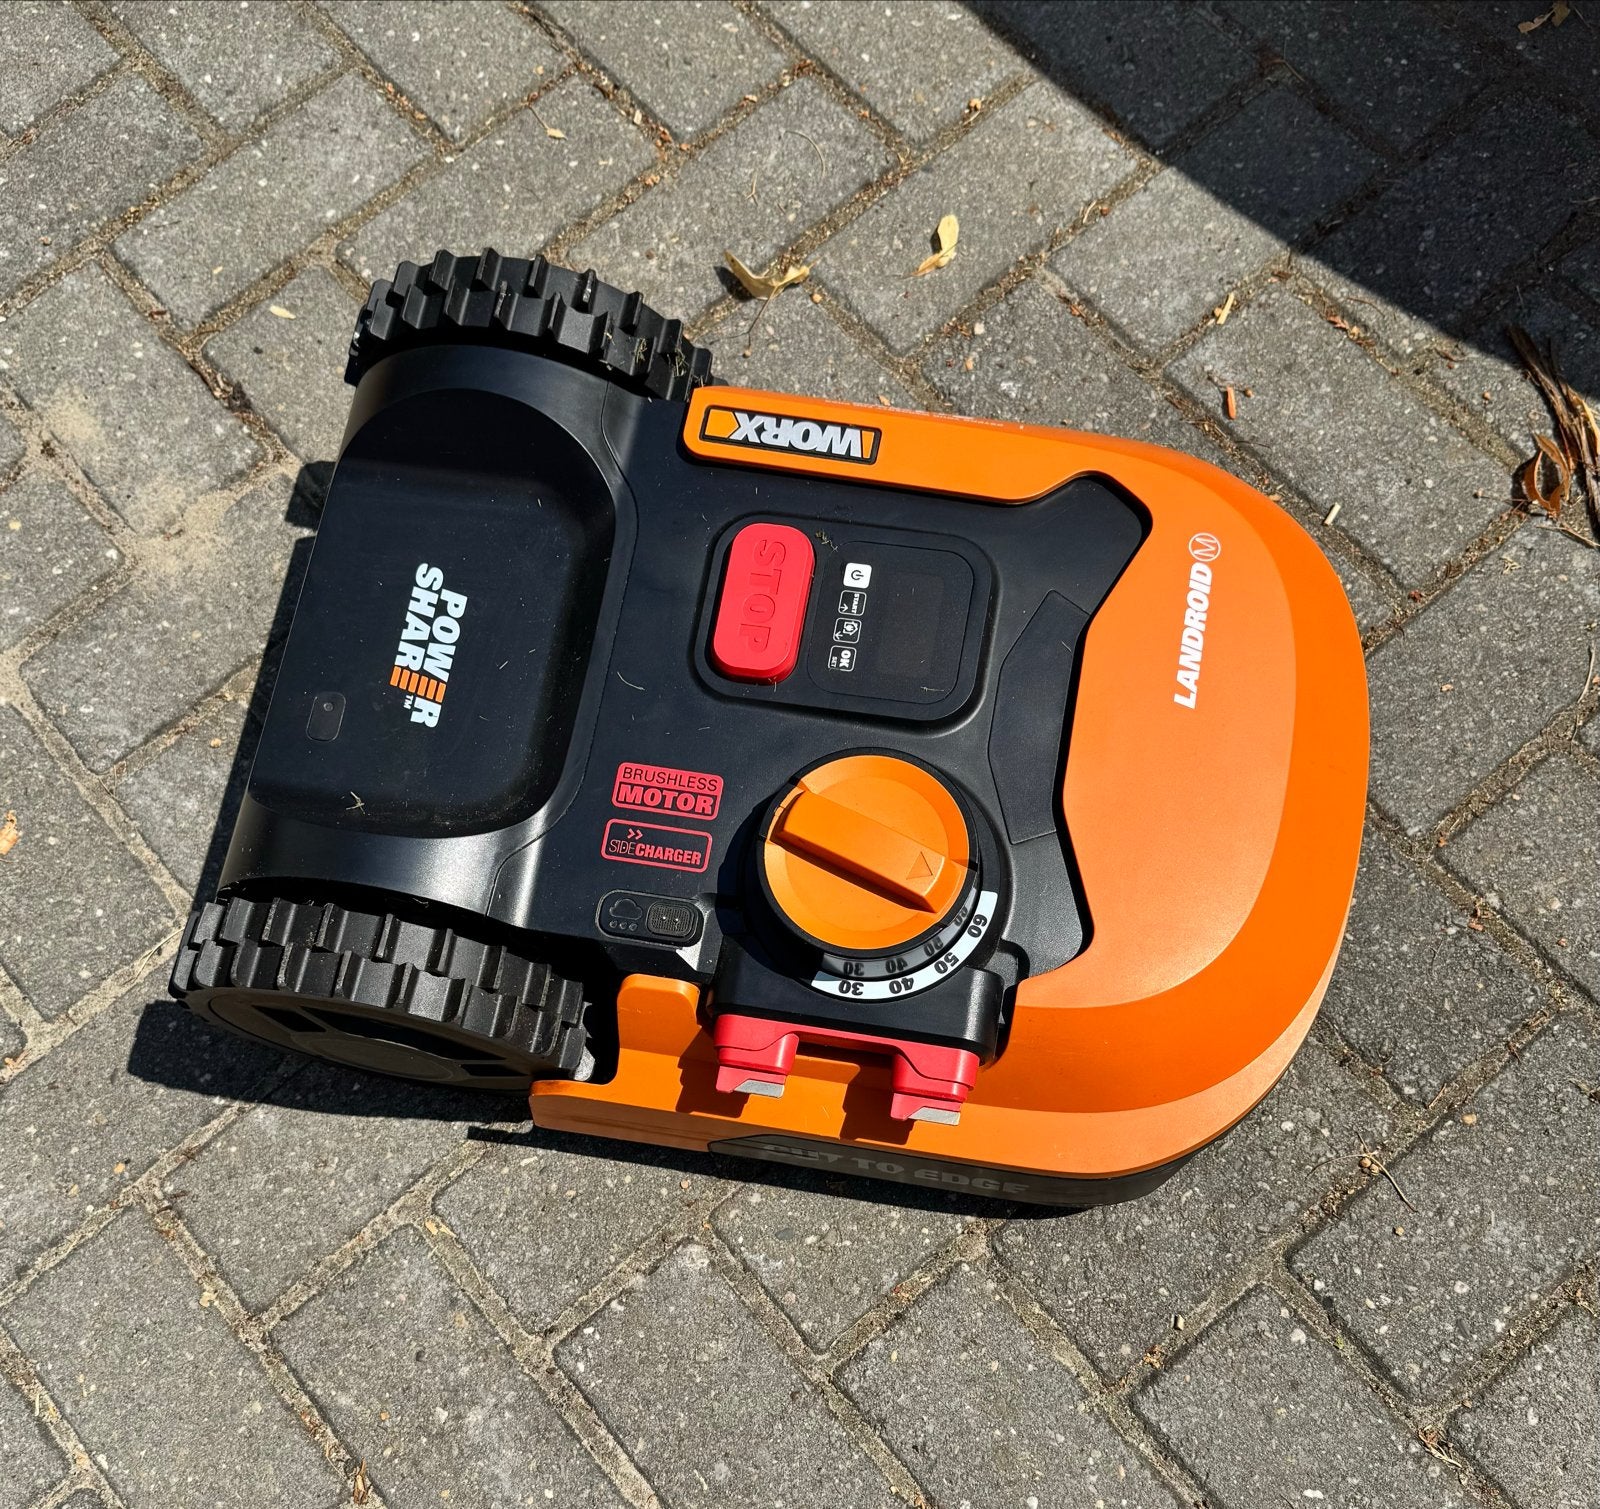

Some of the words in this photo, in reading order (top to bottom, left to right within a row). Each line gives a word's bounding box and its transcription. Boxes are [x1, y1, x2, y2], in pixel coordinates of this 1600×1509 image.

[729, 411, 863, 458] WORX
[739, 539, 787, 652] STOP
[851, 593, 860, 613] START
[389, 563, 444, 692] SHARE
[1173, 562, 1213, 710] LANDROID
[410, 588, 468, 728] POWER
[830, 656, 838, 667] SET
[839, 650, 851, 668] OK
[622, 766, 718, 792] BRUSHLESS
[617, 783, 714, 815] MOTOR
[967, 913, 988, 938] 60
[934, 952, 960, 974] 50
[838, 979, 864, 996] 30
[889, 977, 915, 995] 40
[849, 1156, 905, 1175] TO
[913, 1168, 1030, 1194] EDGE
